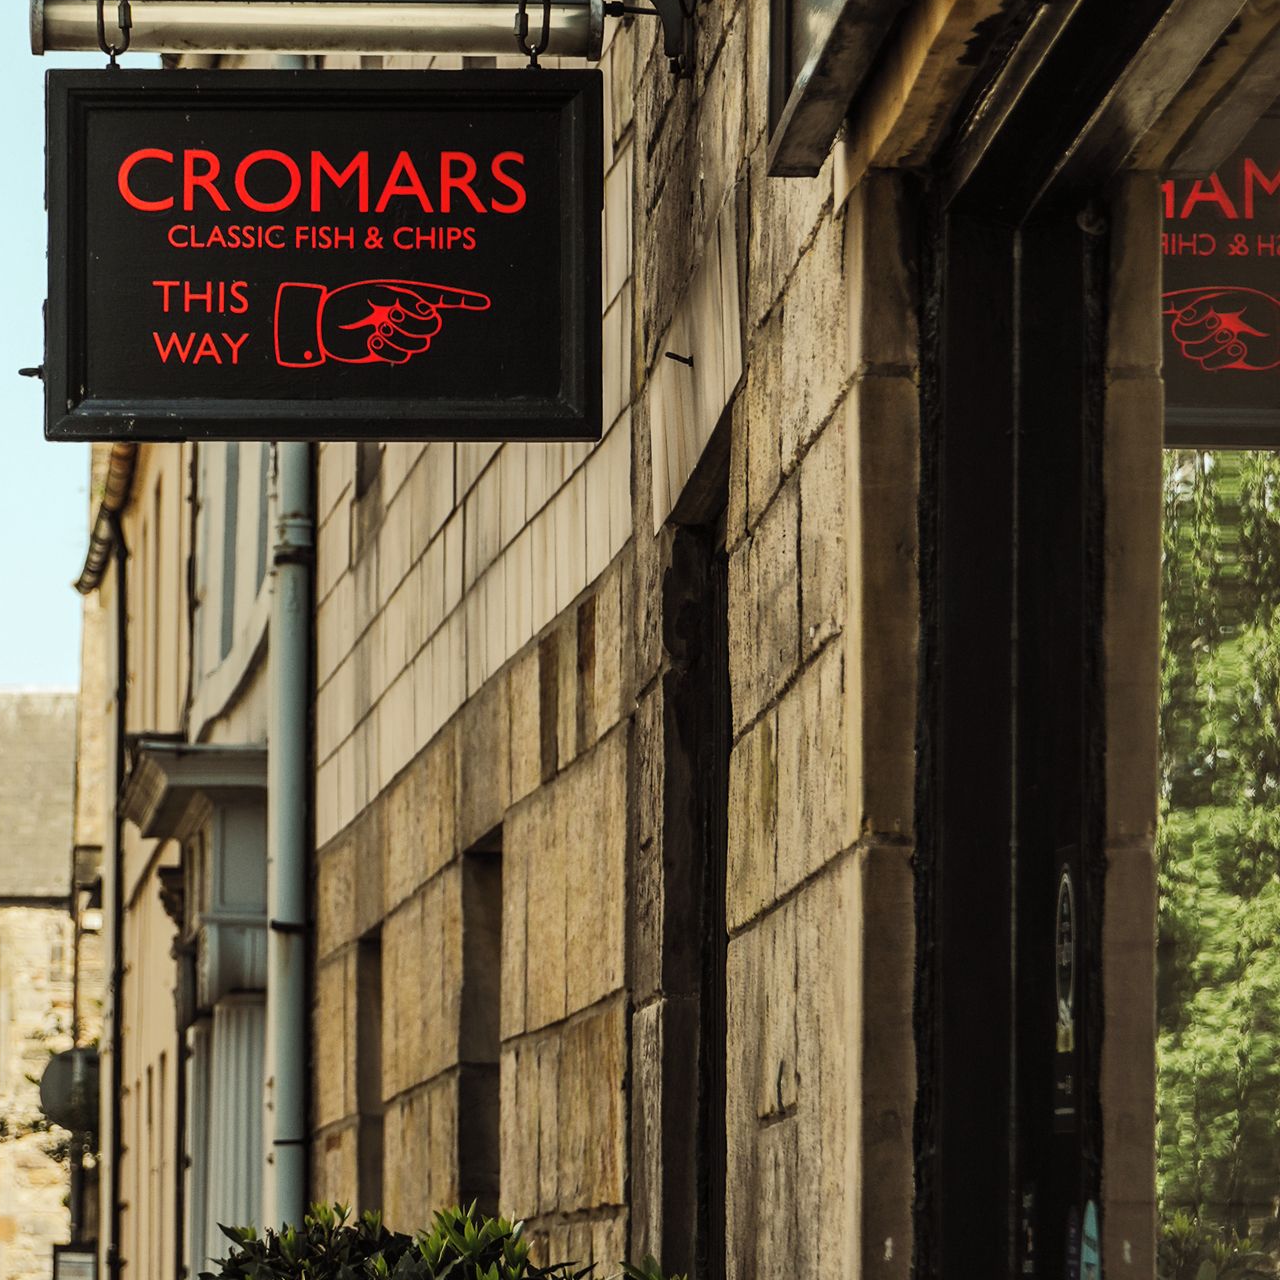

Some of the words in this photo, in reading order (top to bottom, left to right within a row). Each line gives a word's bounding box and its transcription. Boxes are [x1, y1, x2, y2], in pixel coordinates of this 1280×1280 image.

[117, 147, 527, 215] CROMARS
[167, 224, 286, 250] CLASSIC
[295, 225, 355, 250] FISH
[364, 225, 384, 250] &
[392, 225, 477, 251] CHIPS
[151, 279, 249, 315] THIS
[152, 331, 250, 365] WAY
